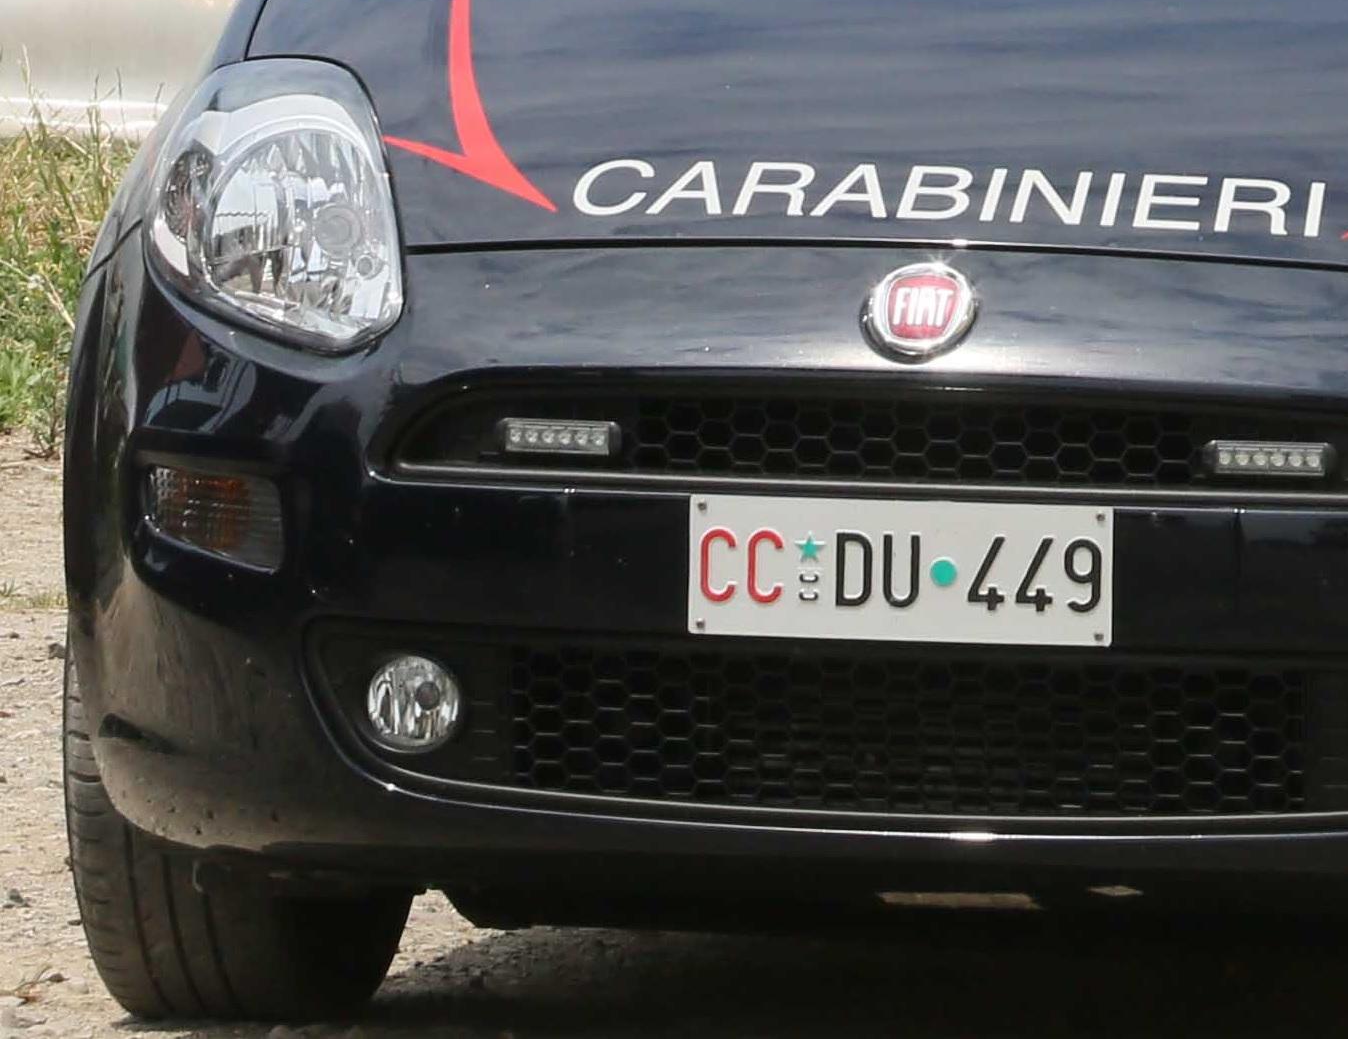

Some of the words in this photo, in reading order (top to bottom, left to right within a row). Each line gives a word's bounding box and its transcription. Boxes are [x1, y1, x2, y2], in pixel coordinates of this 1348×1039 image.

[572, 159, 1326, 238] CARABINIERI
[892, 286, 954, 327] FIAT
[700, 529, 783, 603] CC
[835, 532, 921, 608] DU
[967, 536, 1103, 613] 449
